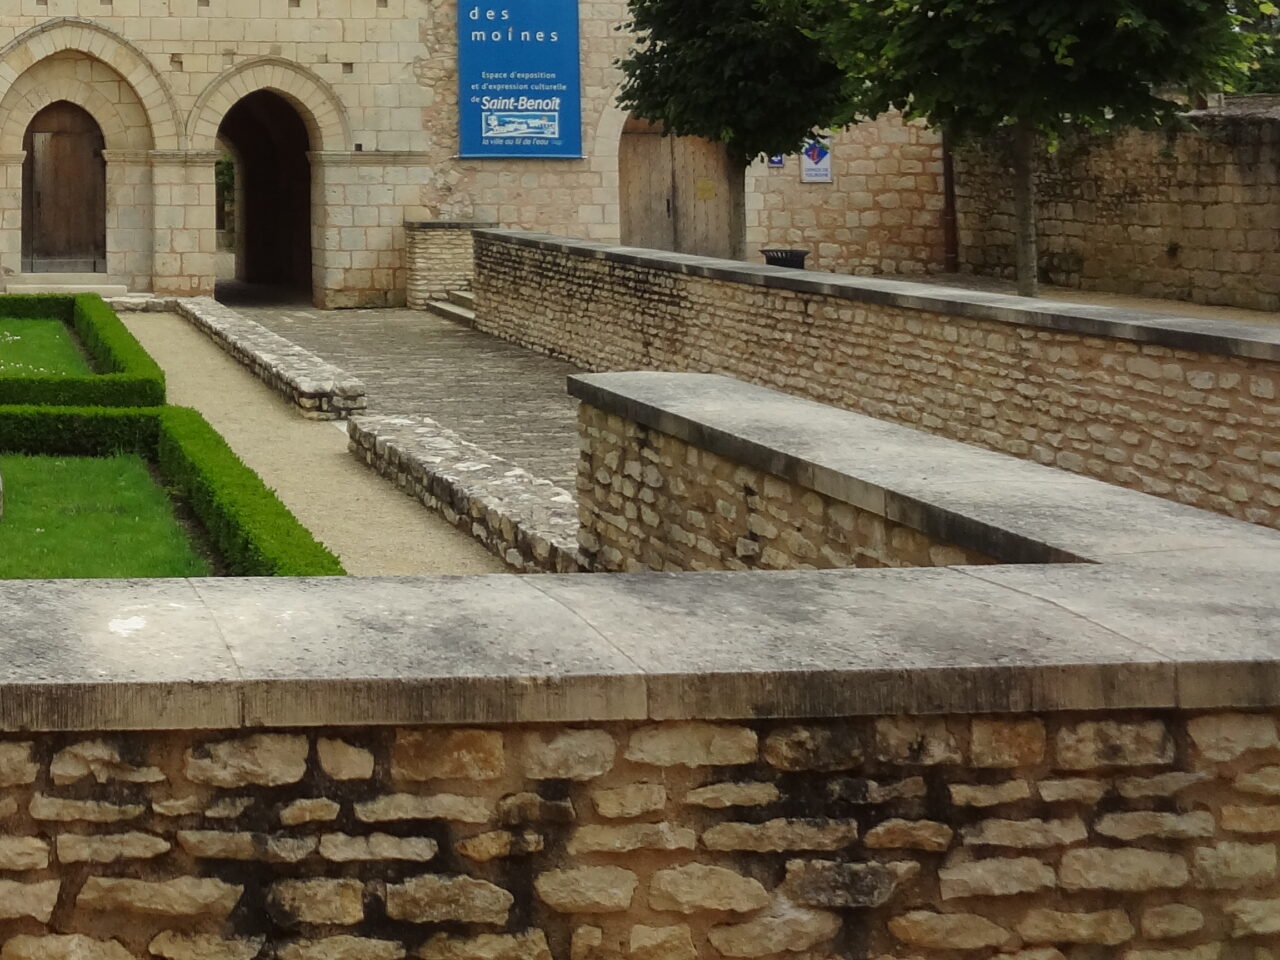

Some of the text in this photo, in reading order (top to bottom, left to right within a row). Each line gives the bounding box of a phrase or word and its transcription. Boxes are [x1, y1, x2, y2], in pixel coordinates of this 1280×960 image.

[469, 6, 510, 20] des
[471, 26, 559, 42] moines
[481, 71, 556, 80] Espace d'exposition
[481, 82, 529, 92] d'expression
[530, 83, 567, 91] culturelle
[470, 95, 561, 111] de Saint-Benoît
